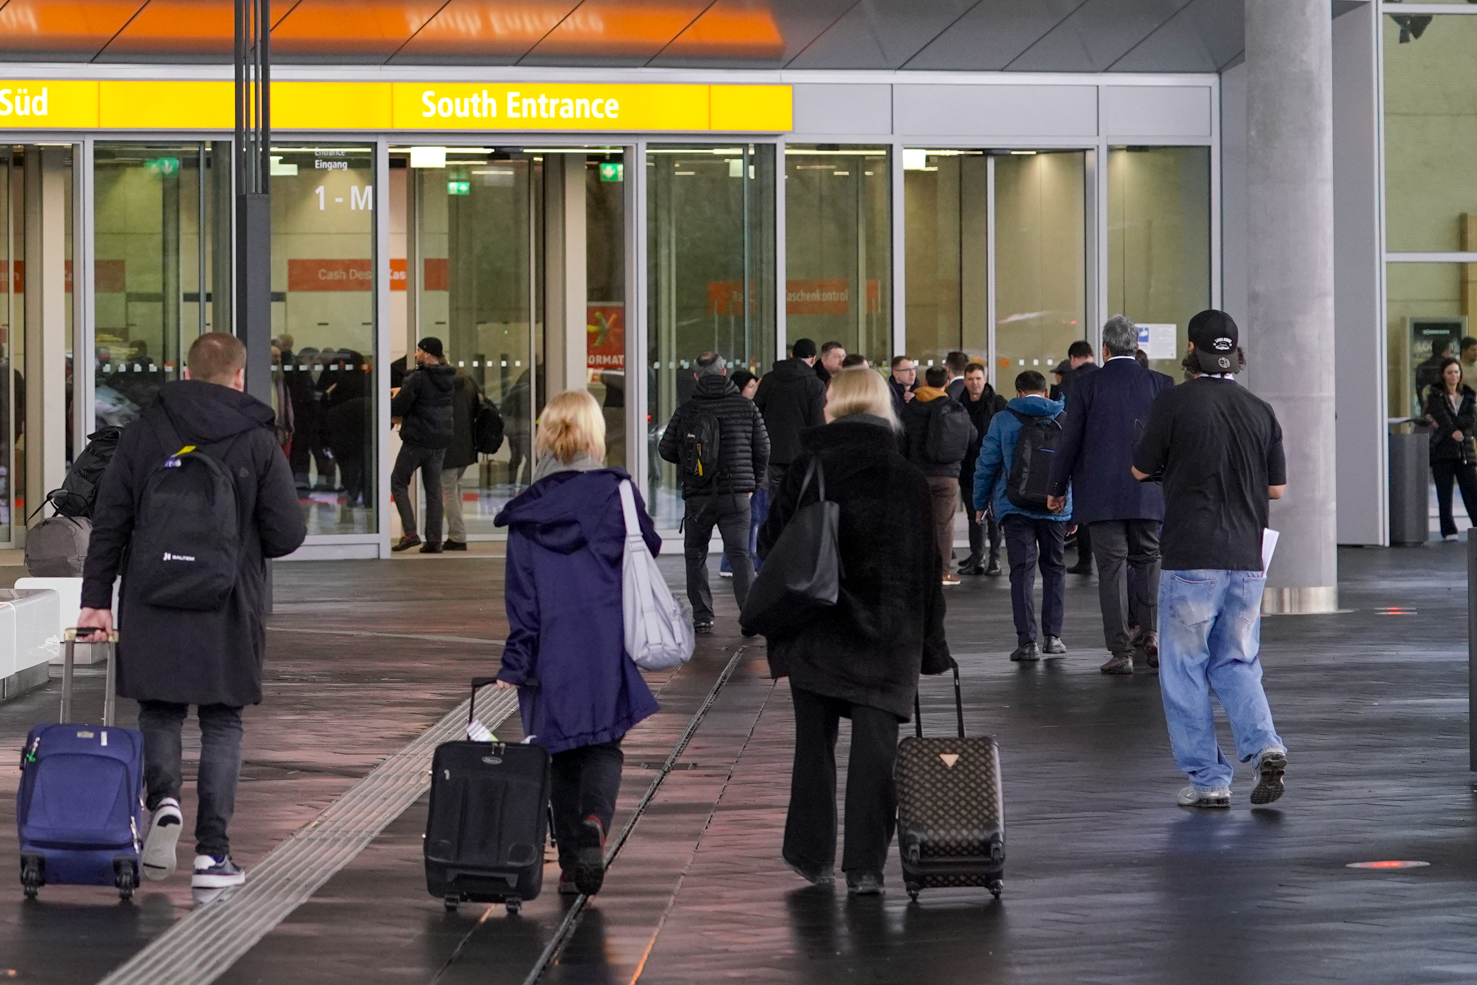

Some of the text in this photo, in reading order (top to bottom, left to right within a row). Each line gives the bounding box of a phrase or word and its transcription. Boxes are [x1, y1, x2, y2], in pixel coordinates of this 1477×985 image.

[421, 89, 620, 119] South Entrance
[315, 159, 348, 171] Eingang
[315, 185, 325, 211] 1
[318, 268, 347, 280] Cash
[349, 269, 372, 280] Des
